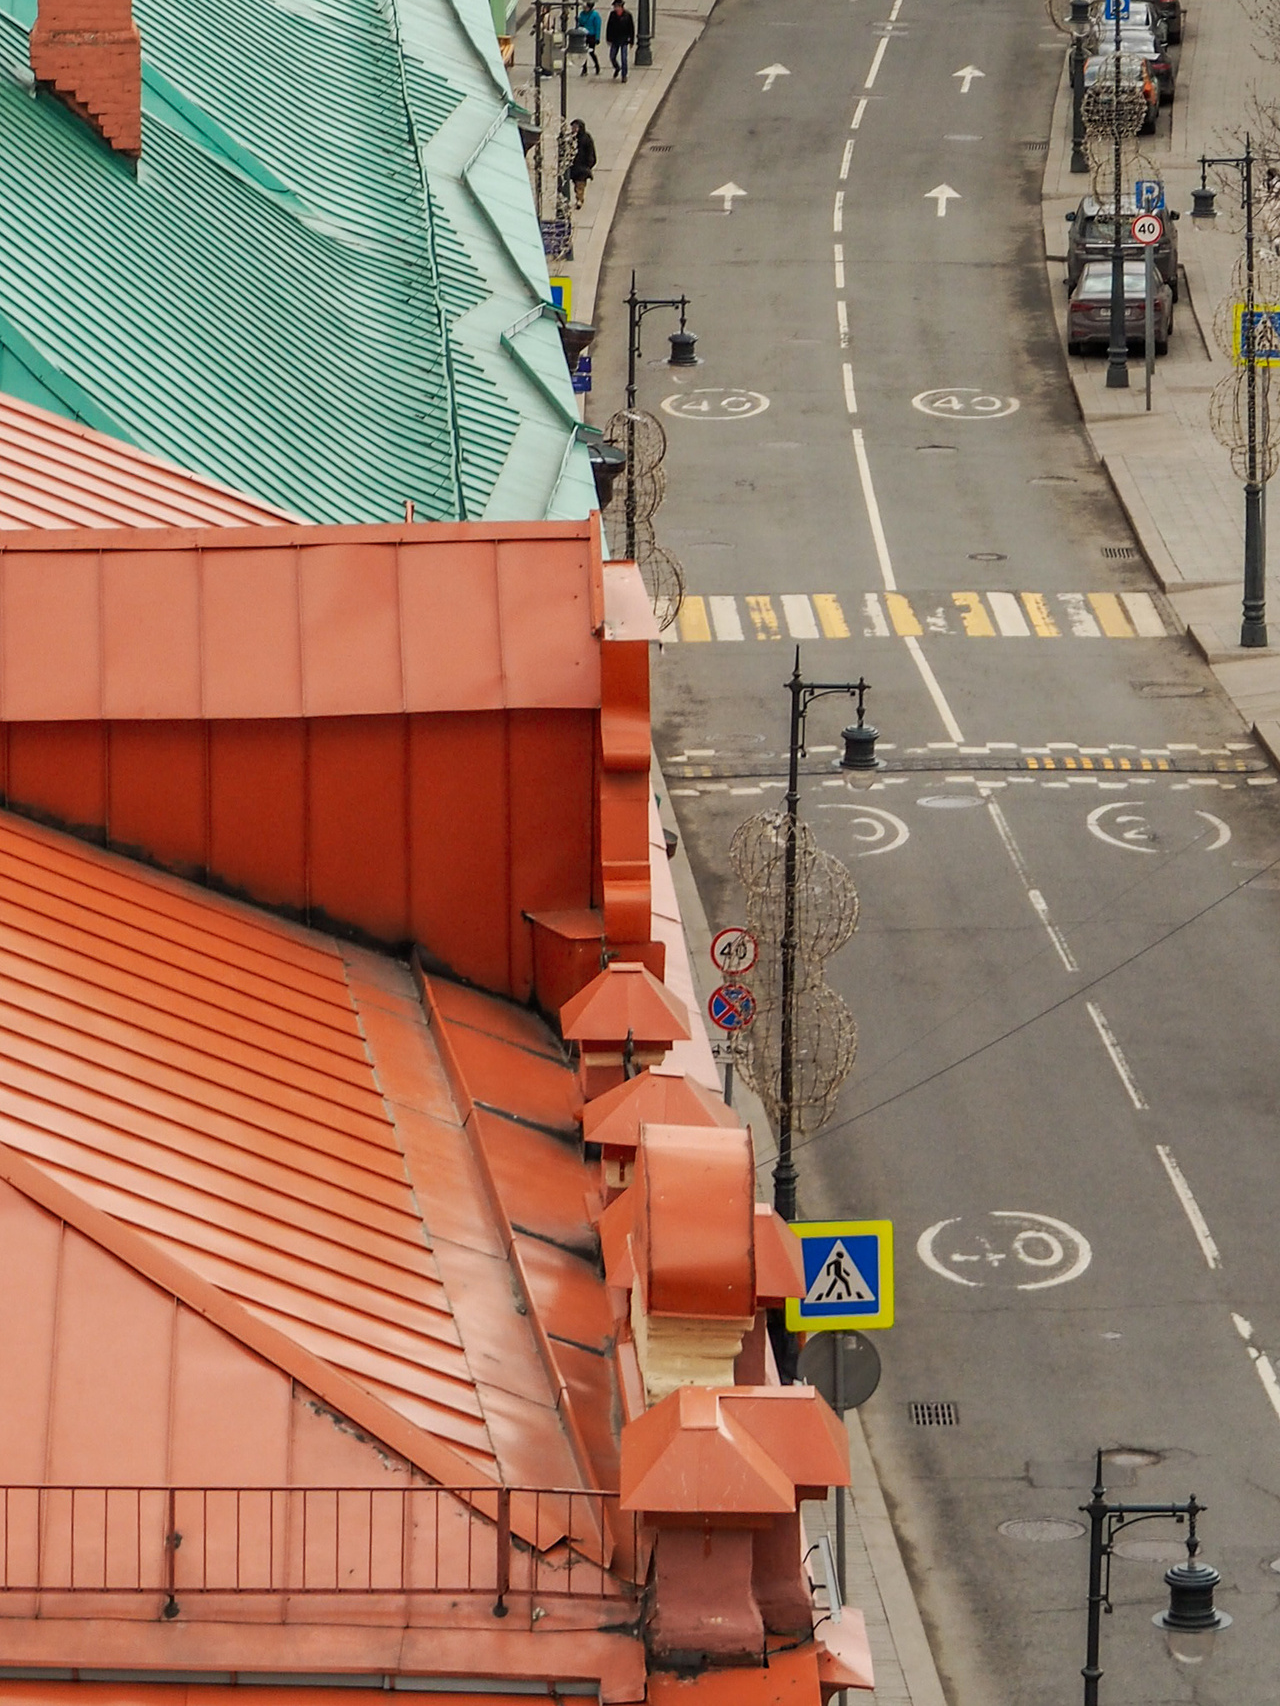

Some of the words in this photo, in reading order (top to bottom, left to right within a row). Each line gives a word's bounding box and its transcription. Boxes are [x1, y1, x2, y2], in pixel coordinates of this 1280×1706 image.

[1142, 182, 1160, 208] P
[1138, 222, 1156, 235] 40
[681, 397, 752, 411] 40
[933, 395, 1002, 411] 40
[720, 942, 747, 960] 40
